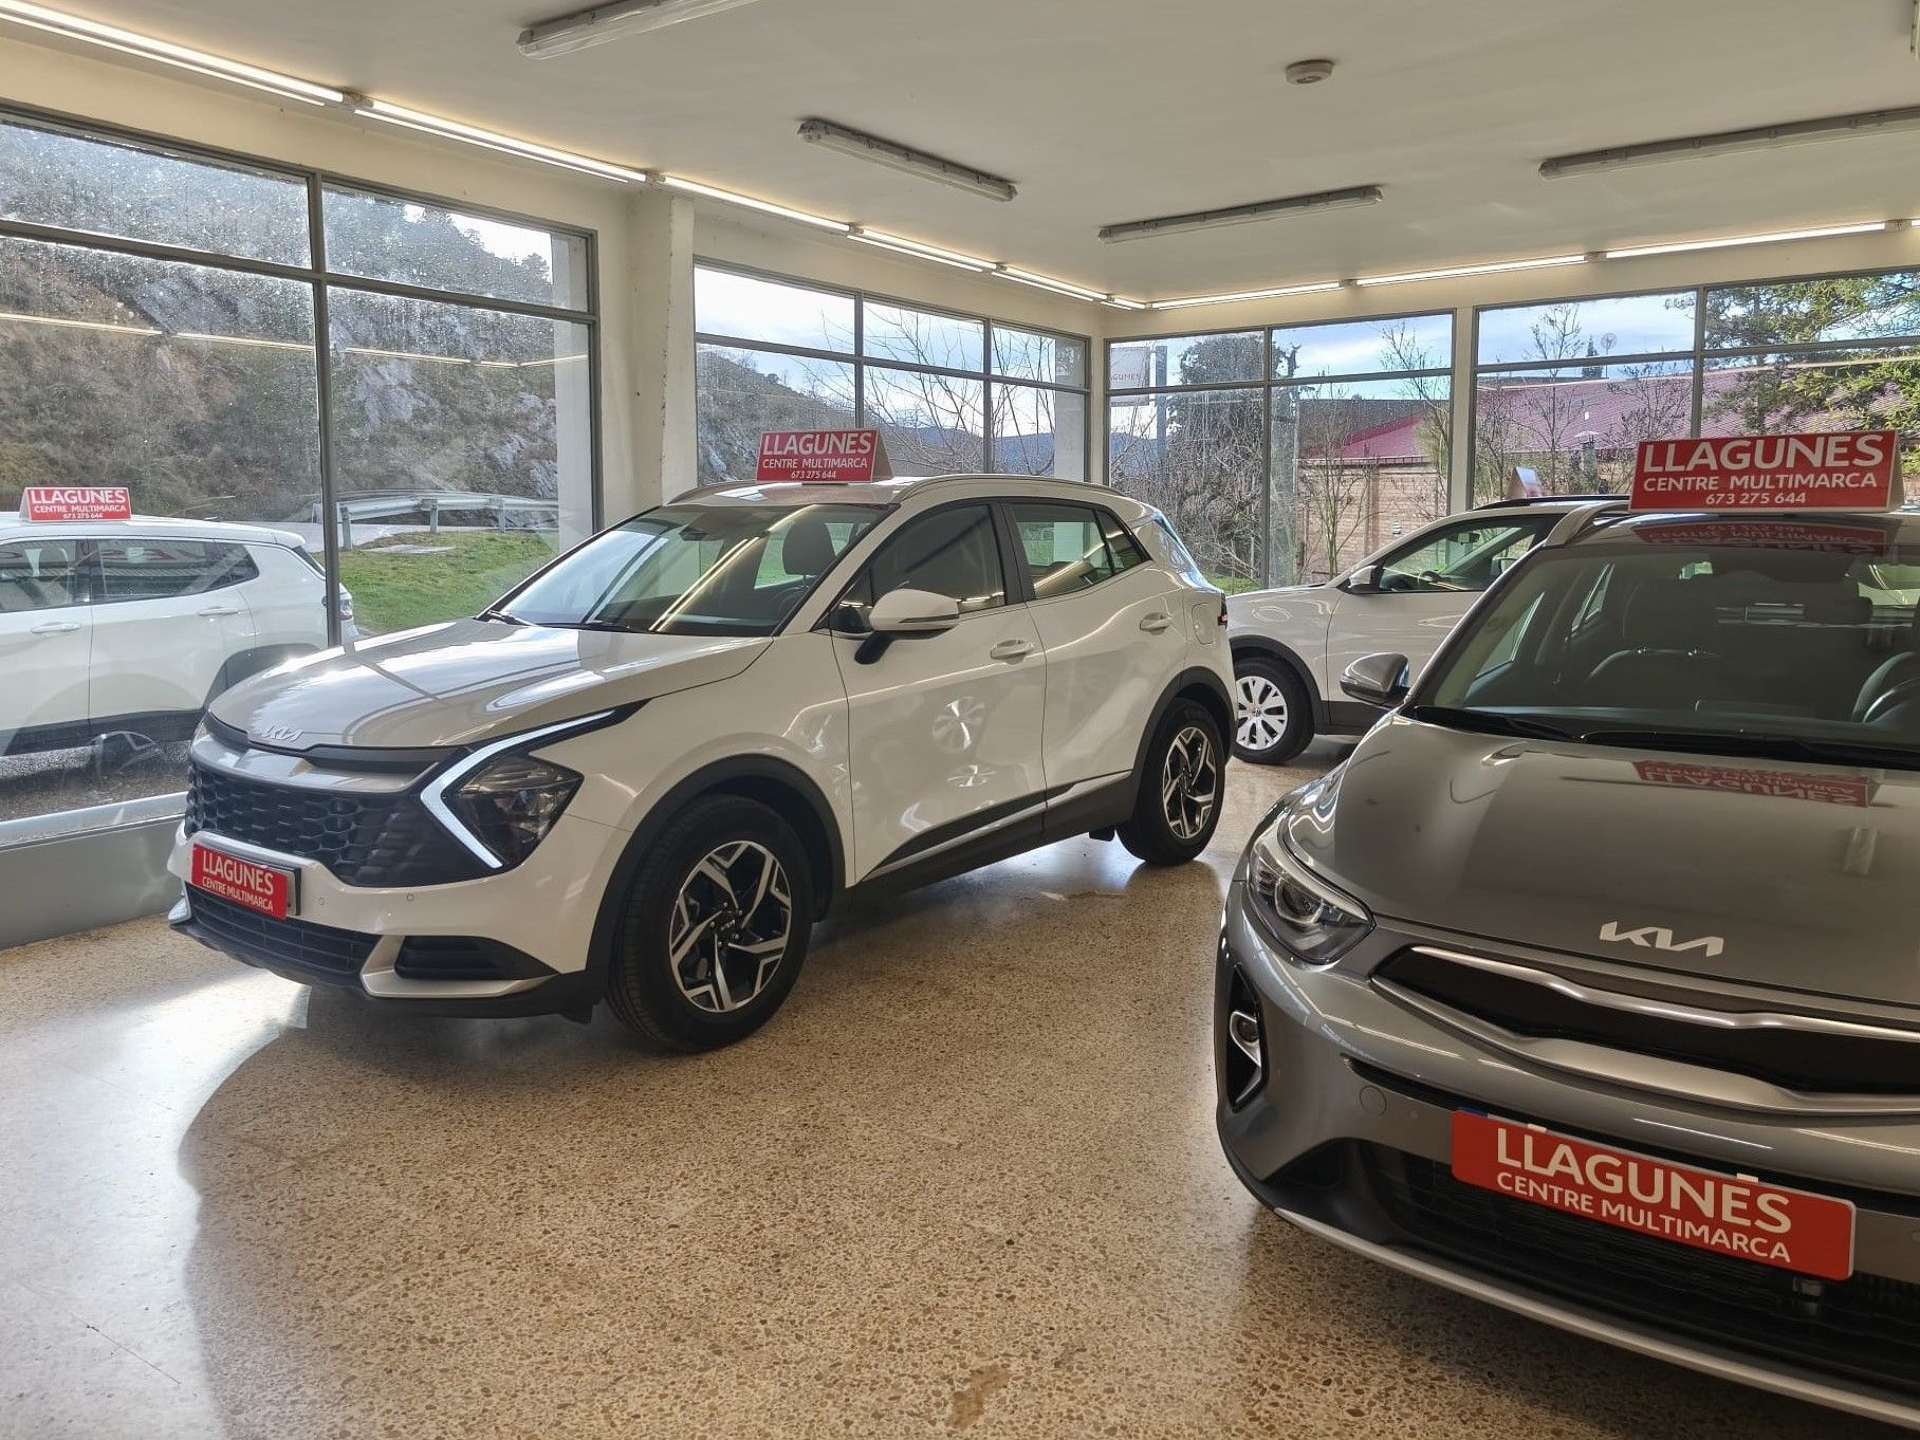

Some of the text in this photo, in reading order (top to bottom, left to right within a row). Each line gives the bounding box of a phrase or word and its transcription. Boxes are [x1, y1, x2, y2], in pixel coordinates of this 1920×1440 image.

[763, 433, 873, 455] LLAGUNES
[1643, 434, 1884, 473] LLAGUNES
[763, 458, 867, 468] CENTRE MULTIMARCA
[791, 470, 836, 479] 673 275 644
[1643, 472, 1877, 492] CENTRE MULTIMARCA
[31, 490, 126, 504] LLAGUNES
[1706, 492, 1807, 505] 673 275 644
[202, 850, 275, 895] LLAGUNES
[202, 876, 274, 912] CENTRE MULTIMARCA
[1497, 1128, 1792, 1234] LLAGUNES
[1497, 1172, 1791, 1263] CENTRE MULTIMARCA
